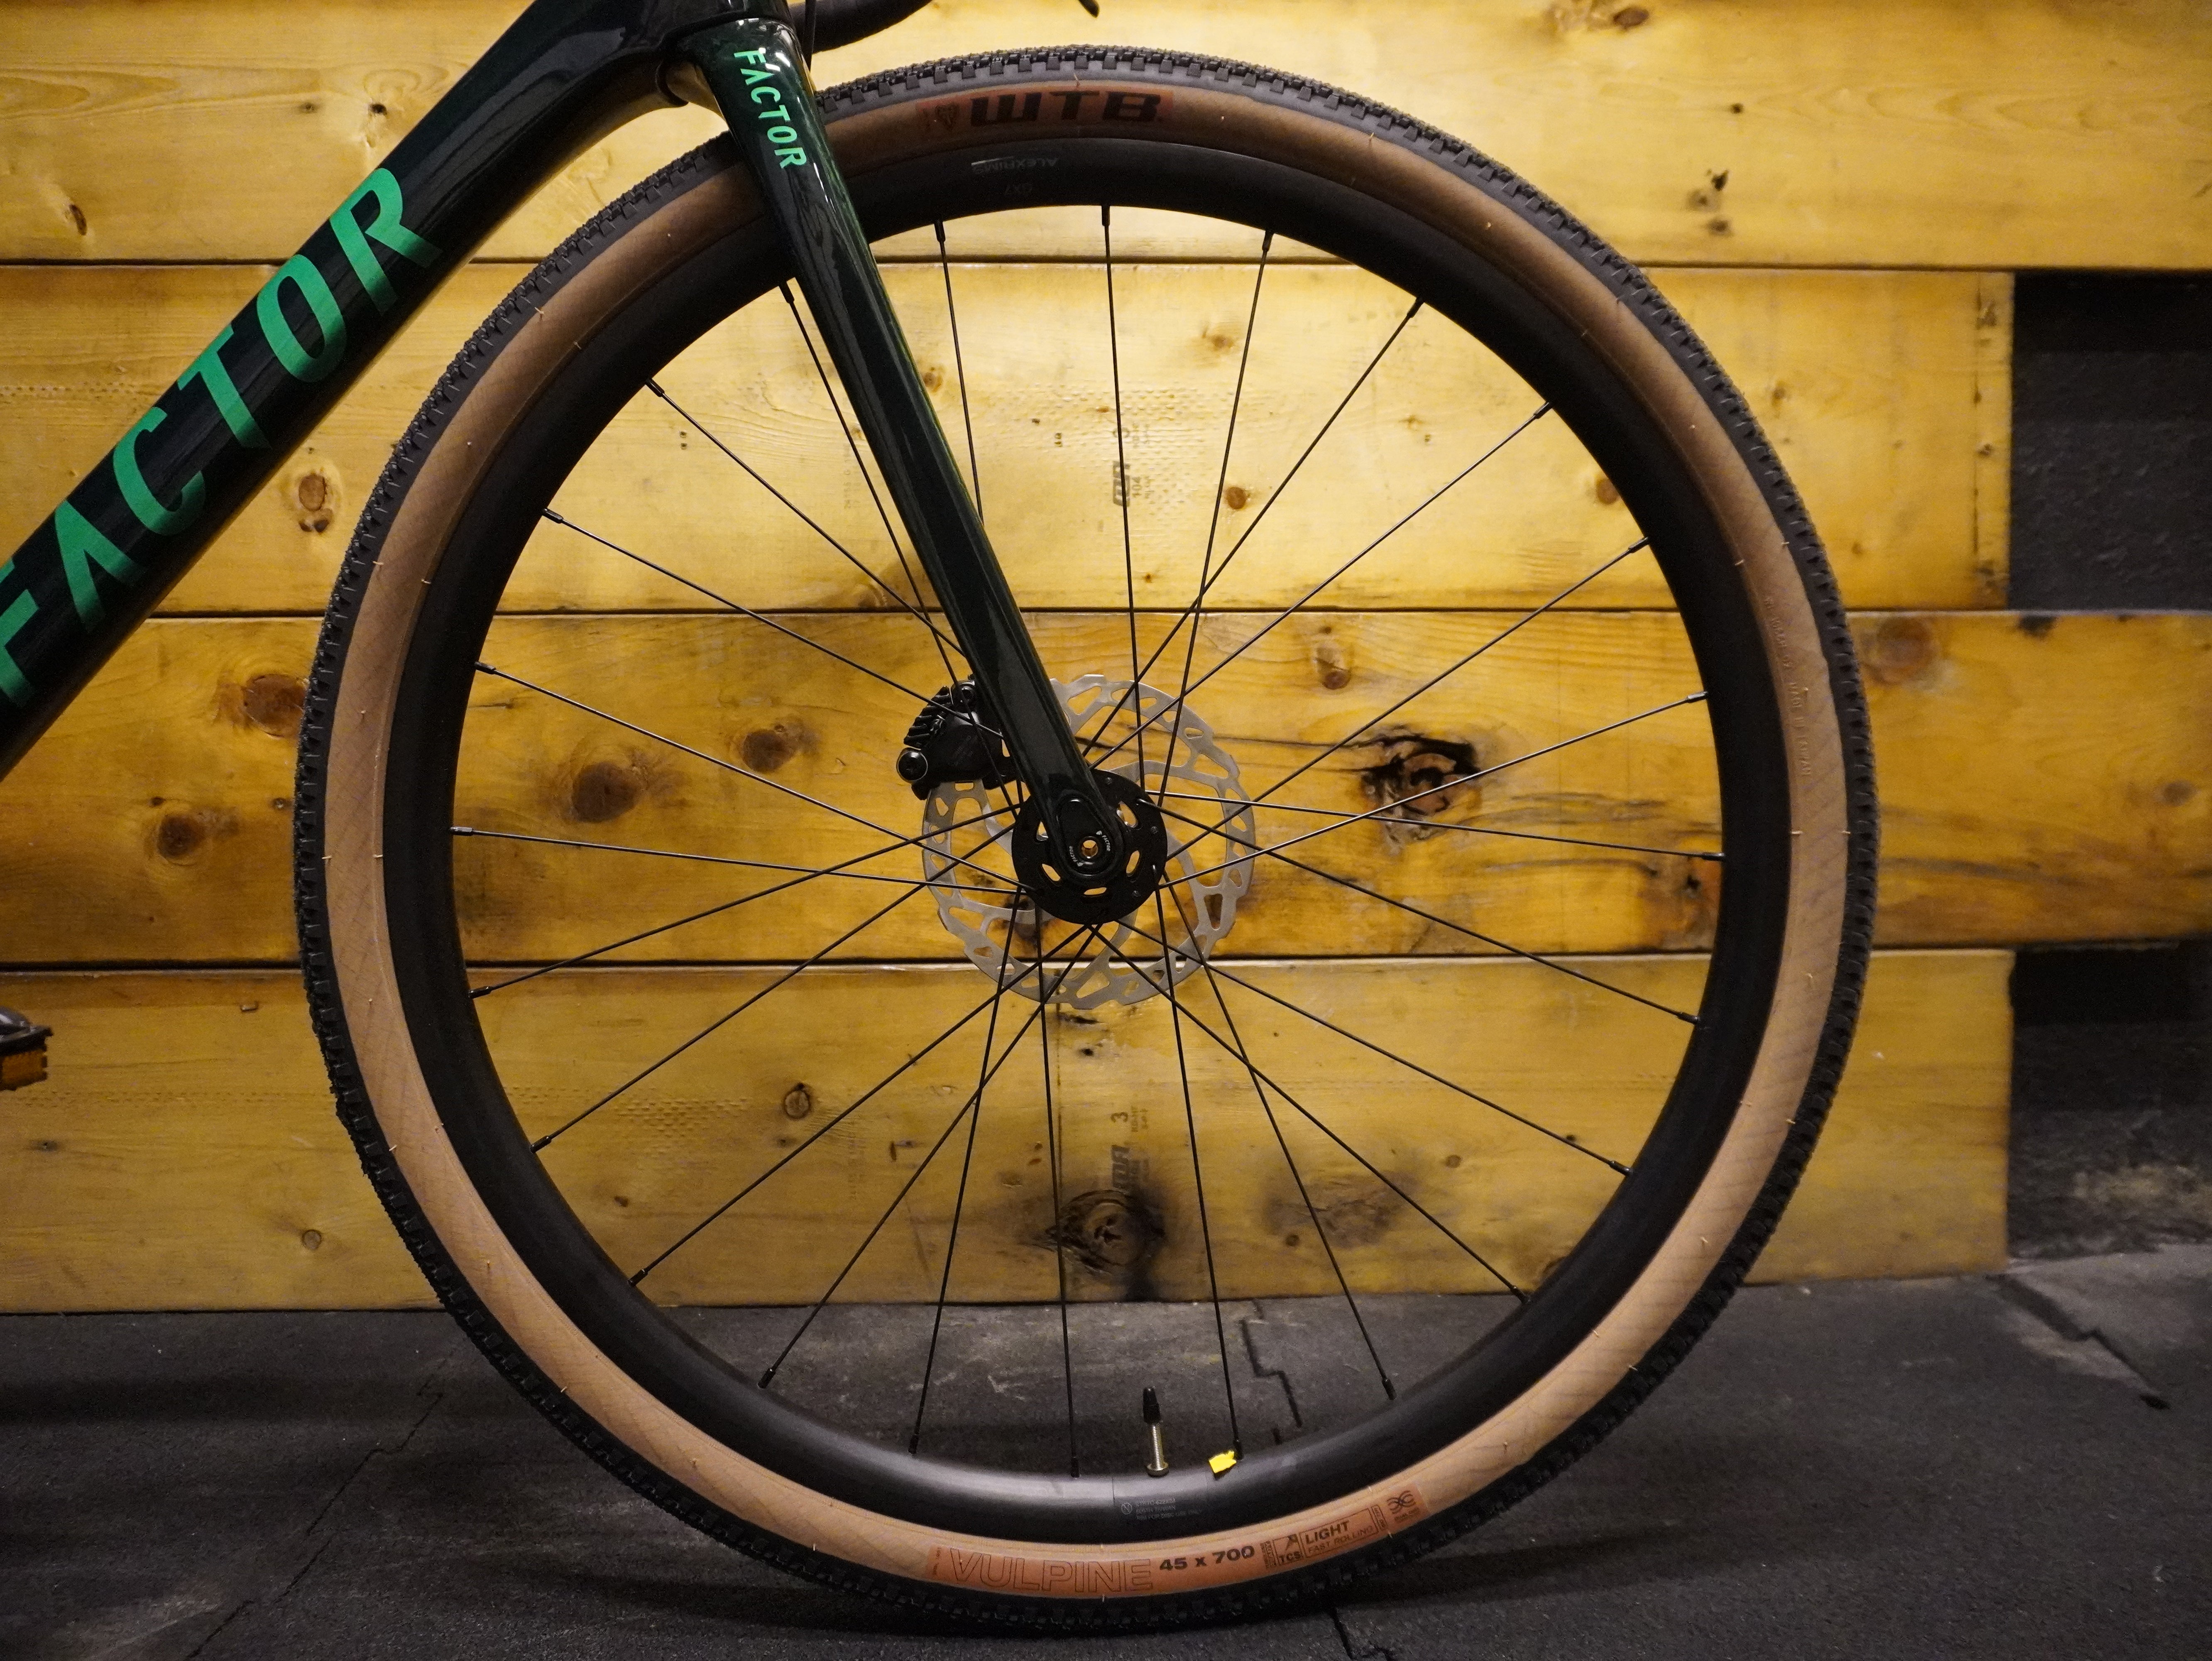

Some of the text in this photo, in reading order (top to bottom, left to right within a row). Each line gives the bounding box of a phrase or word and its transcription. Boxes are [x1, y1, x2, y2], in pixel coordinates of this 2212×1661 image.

[734, 50, 807, 169] FACTOR
[971, 90, 1161, 125] WTB
[1305, 1521, 1349, 1544] LIGHT
[1309, 1526, 1373, 1553] FAST ROLLING
[949, 1547, 1154, 1593] VULPINE
[1160, 1556, 1188, 1571] 45
[1212, 1545, 1255, 1565] 700
[1279, 1551, 1302, 1563] TCS
